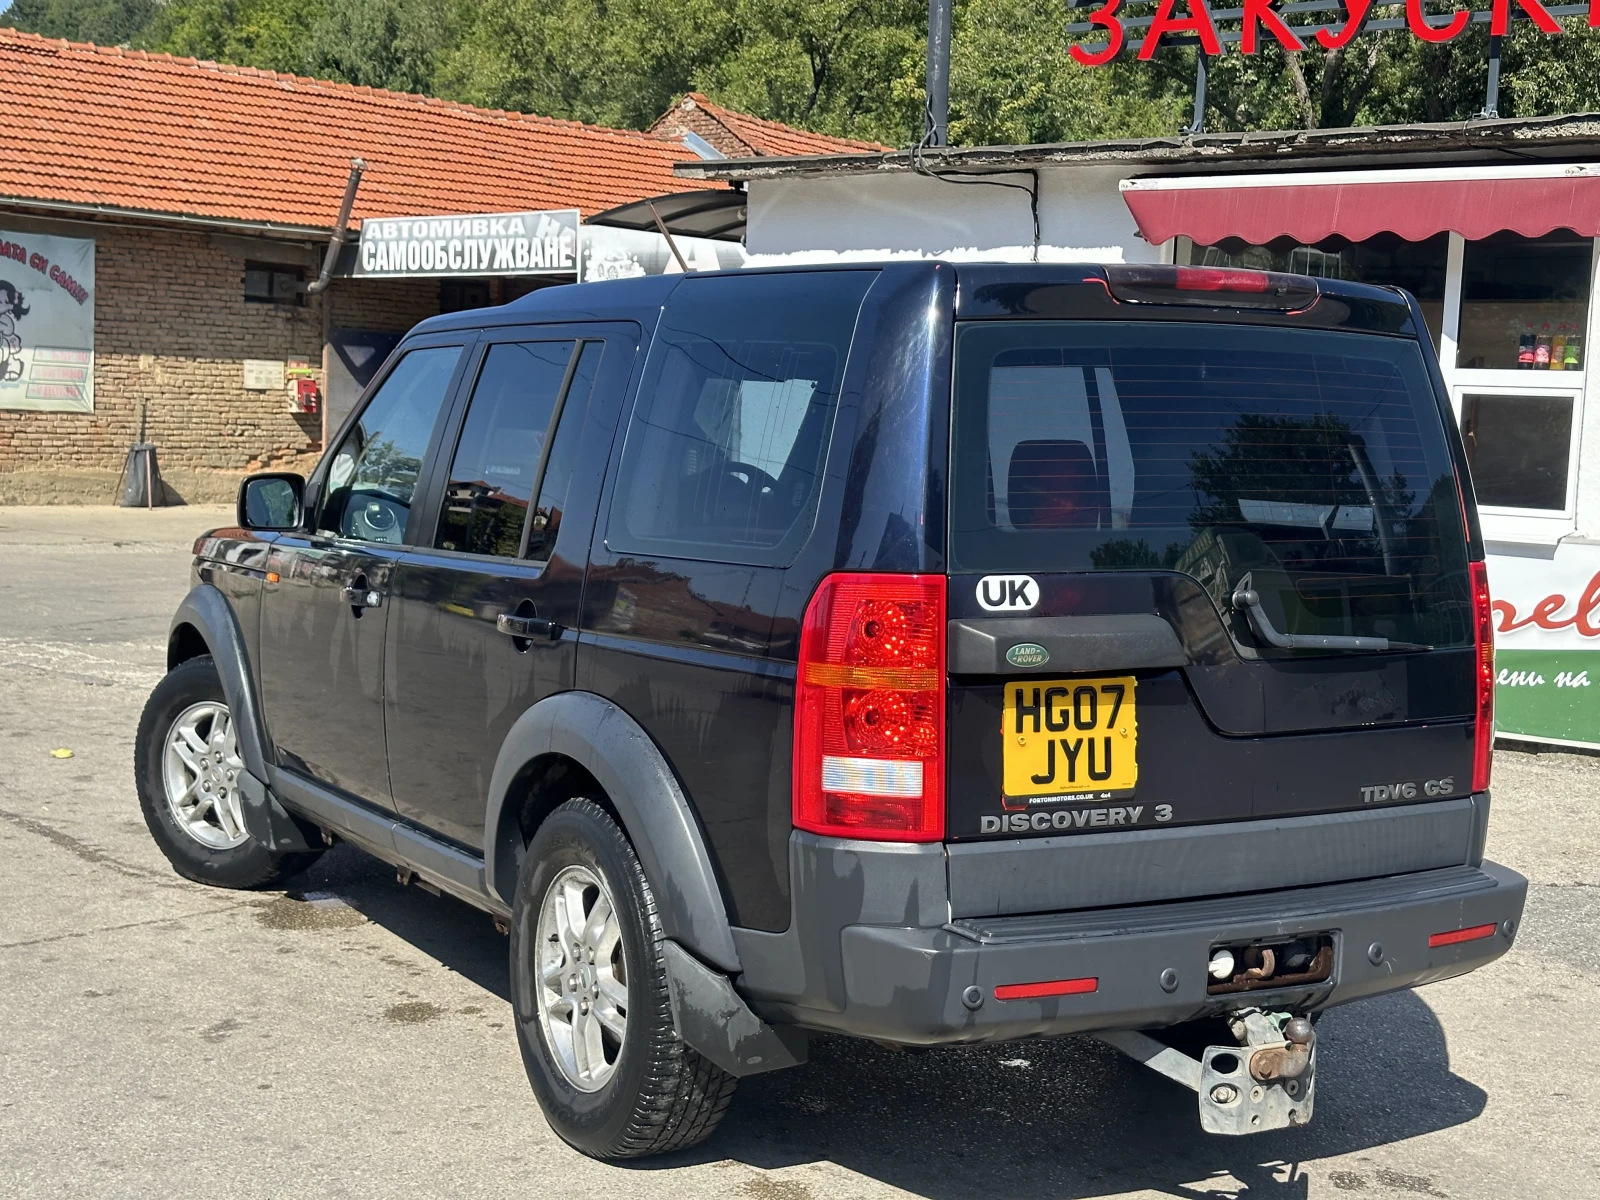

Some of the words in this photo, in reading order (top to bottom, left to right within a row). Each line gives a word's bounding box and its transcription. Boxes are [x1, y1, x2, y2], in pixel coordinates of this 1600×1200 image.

[1069, 0, 1600, 66] ЗАКУСК
[365, 217, 526, 240] АВТОМИВКА
[29, 252, 49, 275] СИ
[361, 235, 574, 272] САМООБСЛУЖВАНЕ
[982, 579, 1031, 607] UK
[1015, 684, 1125, 734] HG07
[1030, 736, 1112, 785] JYU
[1360, 781, 1417, 803] TDV6
[1424, 778, 1454, 797] GS
[980, 805, 1144, 834] DISCOVERY
[1154, 804, 1173, 823] 3
